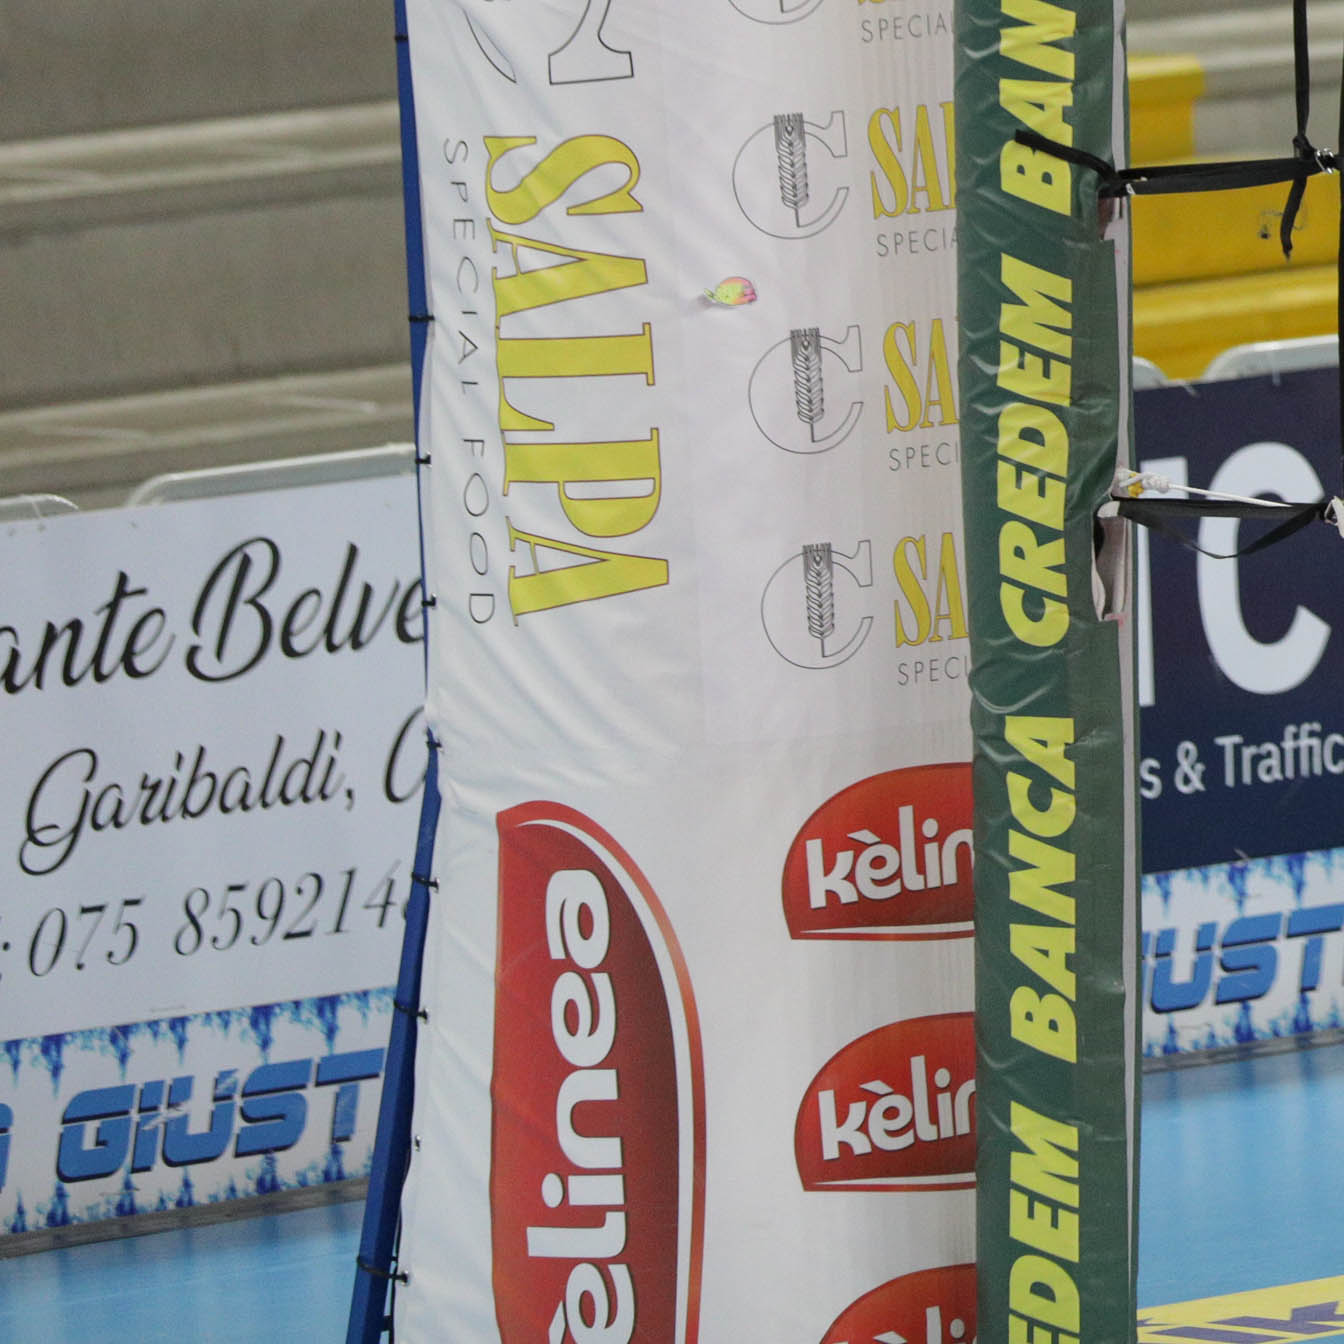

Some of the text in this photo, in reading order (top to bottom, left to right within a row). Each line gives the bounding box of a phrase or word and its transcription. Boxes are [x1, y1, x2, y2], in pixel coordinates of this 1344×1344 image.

[860, 12, 954, 44] SPECIA
[442, 138, 496, 624] SPECIAL FOOD
[483, 133, 670, 626] SALPA
[995, 255, 1074, 647] CREDEM
[0, 535, 429, 696] ante Belve
[18, 727, 357, 877] Garibaldi,
[27, 860, 410, 978] 075 859214
[1003, 715, 1078, 1064] BANCA
[56, 1046, 388, 1185] GIUST
[526, 868, 638, 1344] èlinea
